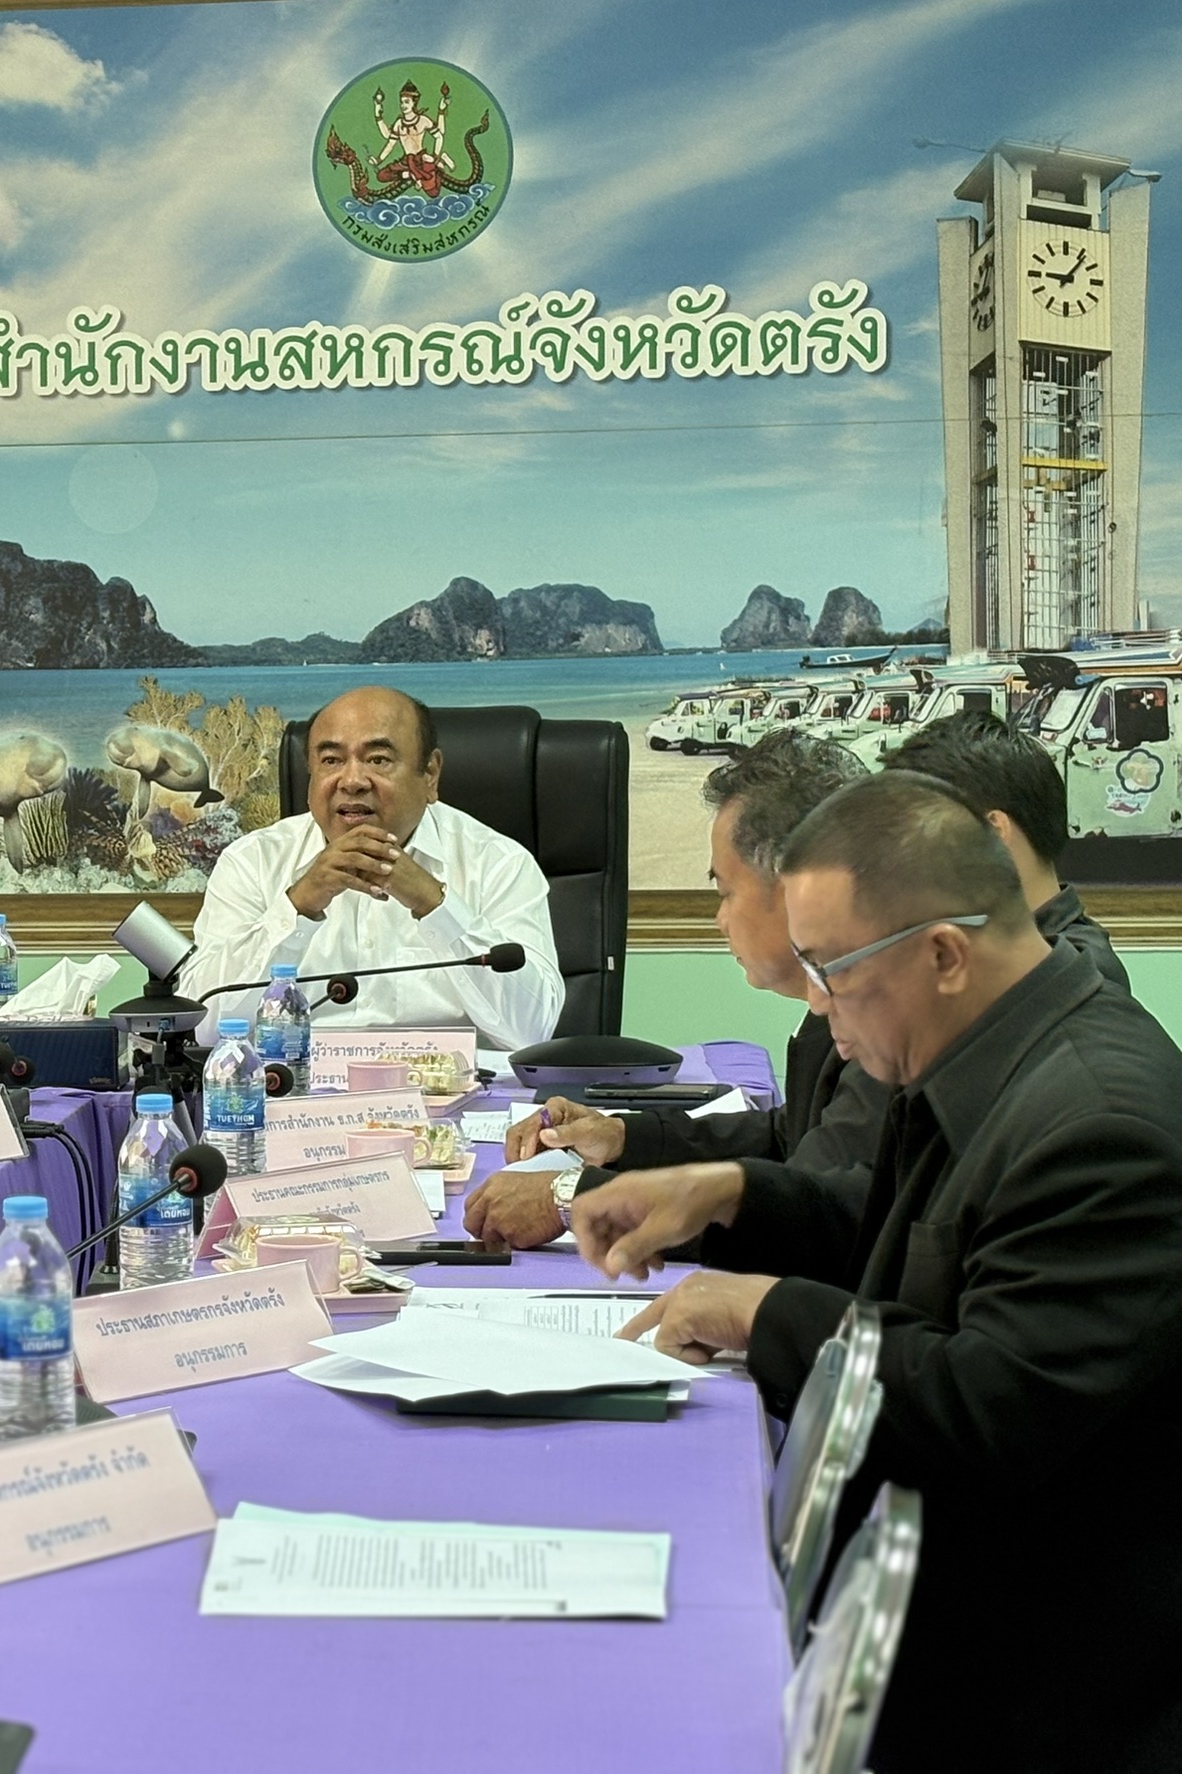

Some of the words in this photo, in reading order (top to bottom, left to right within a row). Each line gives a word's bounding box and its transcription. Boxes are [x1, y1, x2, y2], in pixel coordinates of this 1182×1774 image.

[341, 199, 490, 256] กรมส่งเสริมสหกรณ์
[95, 1287, 286, 1337] ประธานสภาเกษตรกรจังหวัดตรัง
[173, 1341, 249, 1373] อนุกรรมการ
